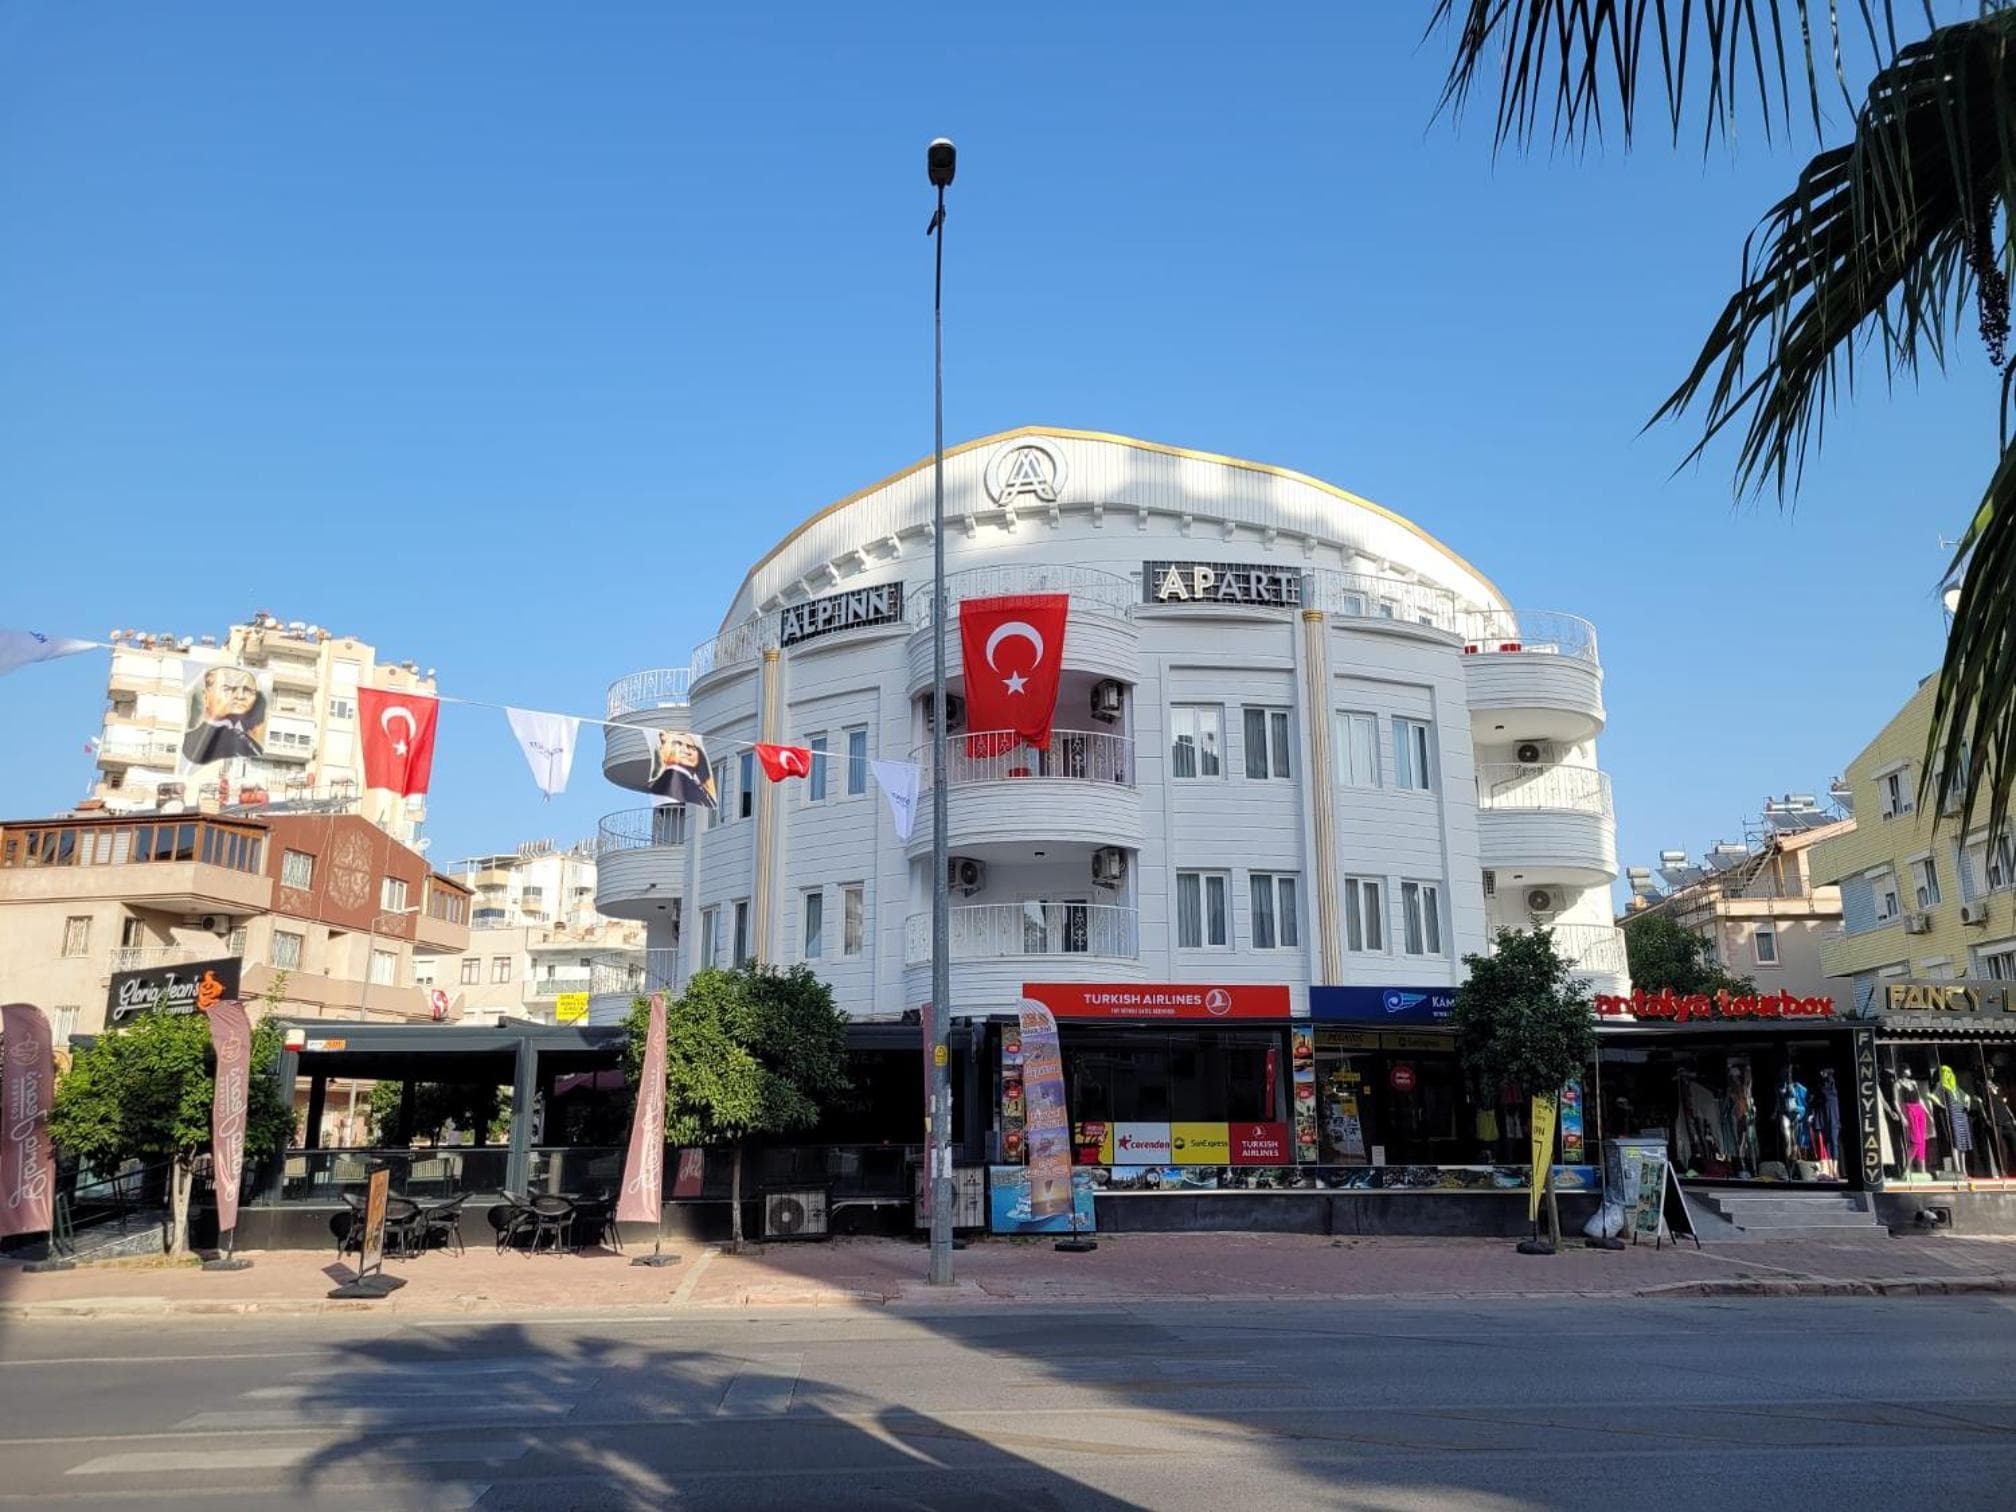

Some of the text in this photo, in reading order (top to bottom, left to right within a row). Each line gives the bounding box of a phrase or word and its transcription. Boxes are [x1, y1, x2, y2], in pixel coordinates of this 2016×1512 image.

[1159, 565, 1293, 601] APART
[113, 976, 160, 1020] Gloria
[1084, 994, 1202, 1005] TURKISH AIRLINES
[1432, 996, 1457, 1008] KAM
[1886, 984, 1980, 1011] FANCY
[1594, 988, 1836, 1023] antalya tourbox
[1131, 1139, 1170, 1150] corendon
[1190, 1139, 1228, 1149] SunExpress
[1242, 1140, 1278, 1148] TURKISH
[1242, 1149, 1279, 1157] AIRLINES
